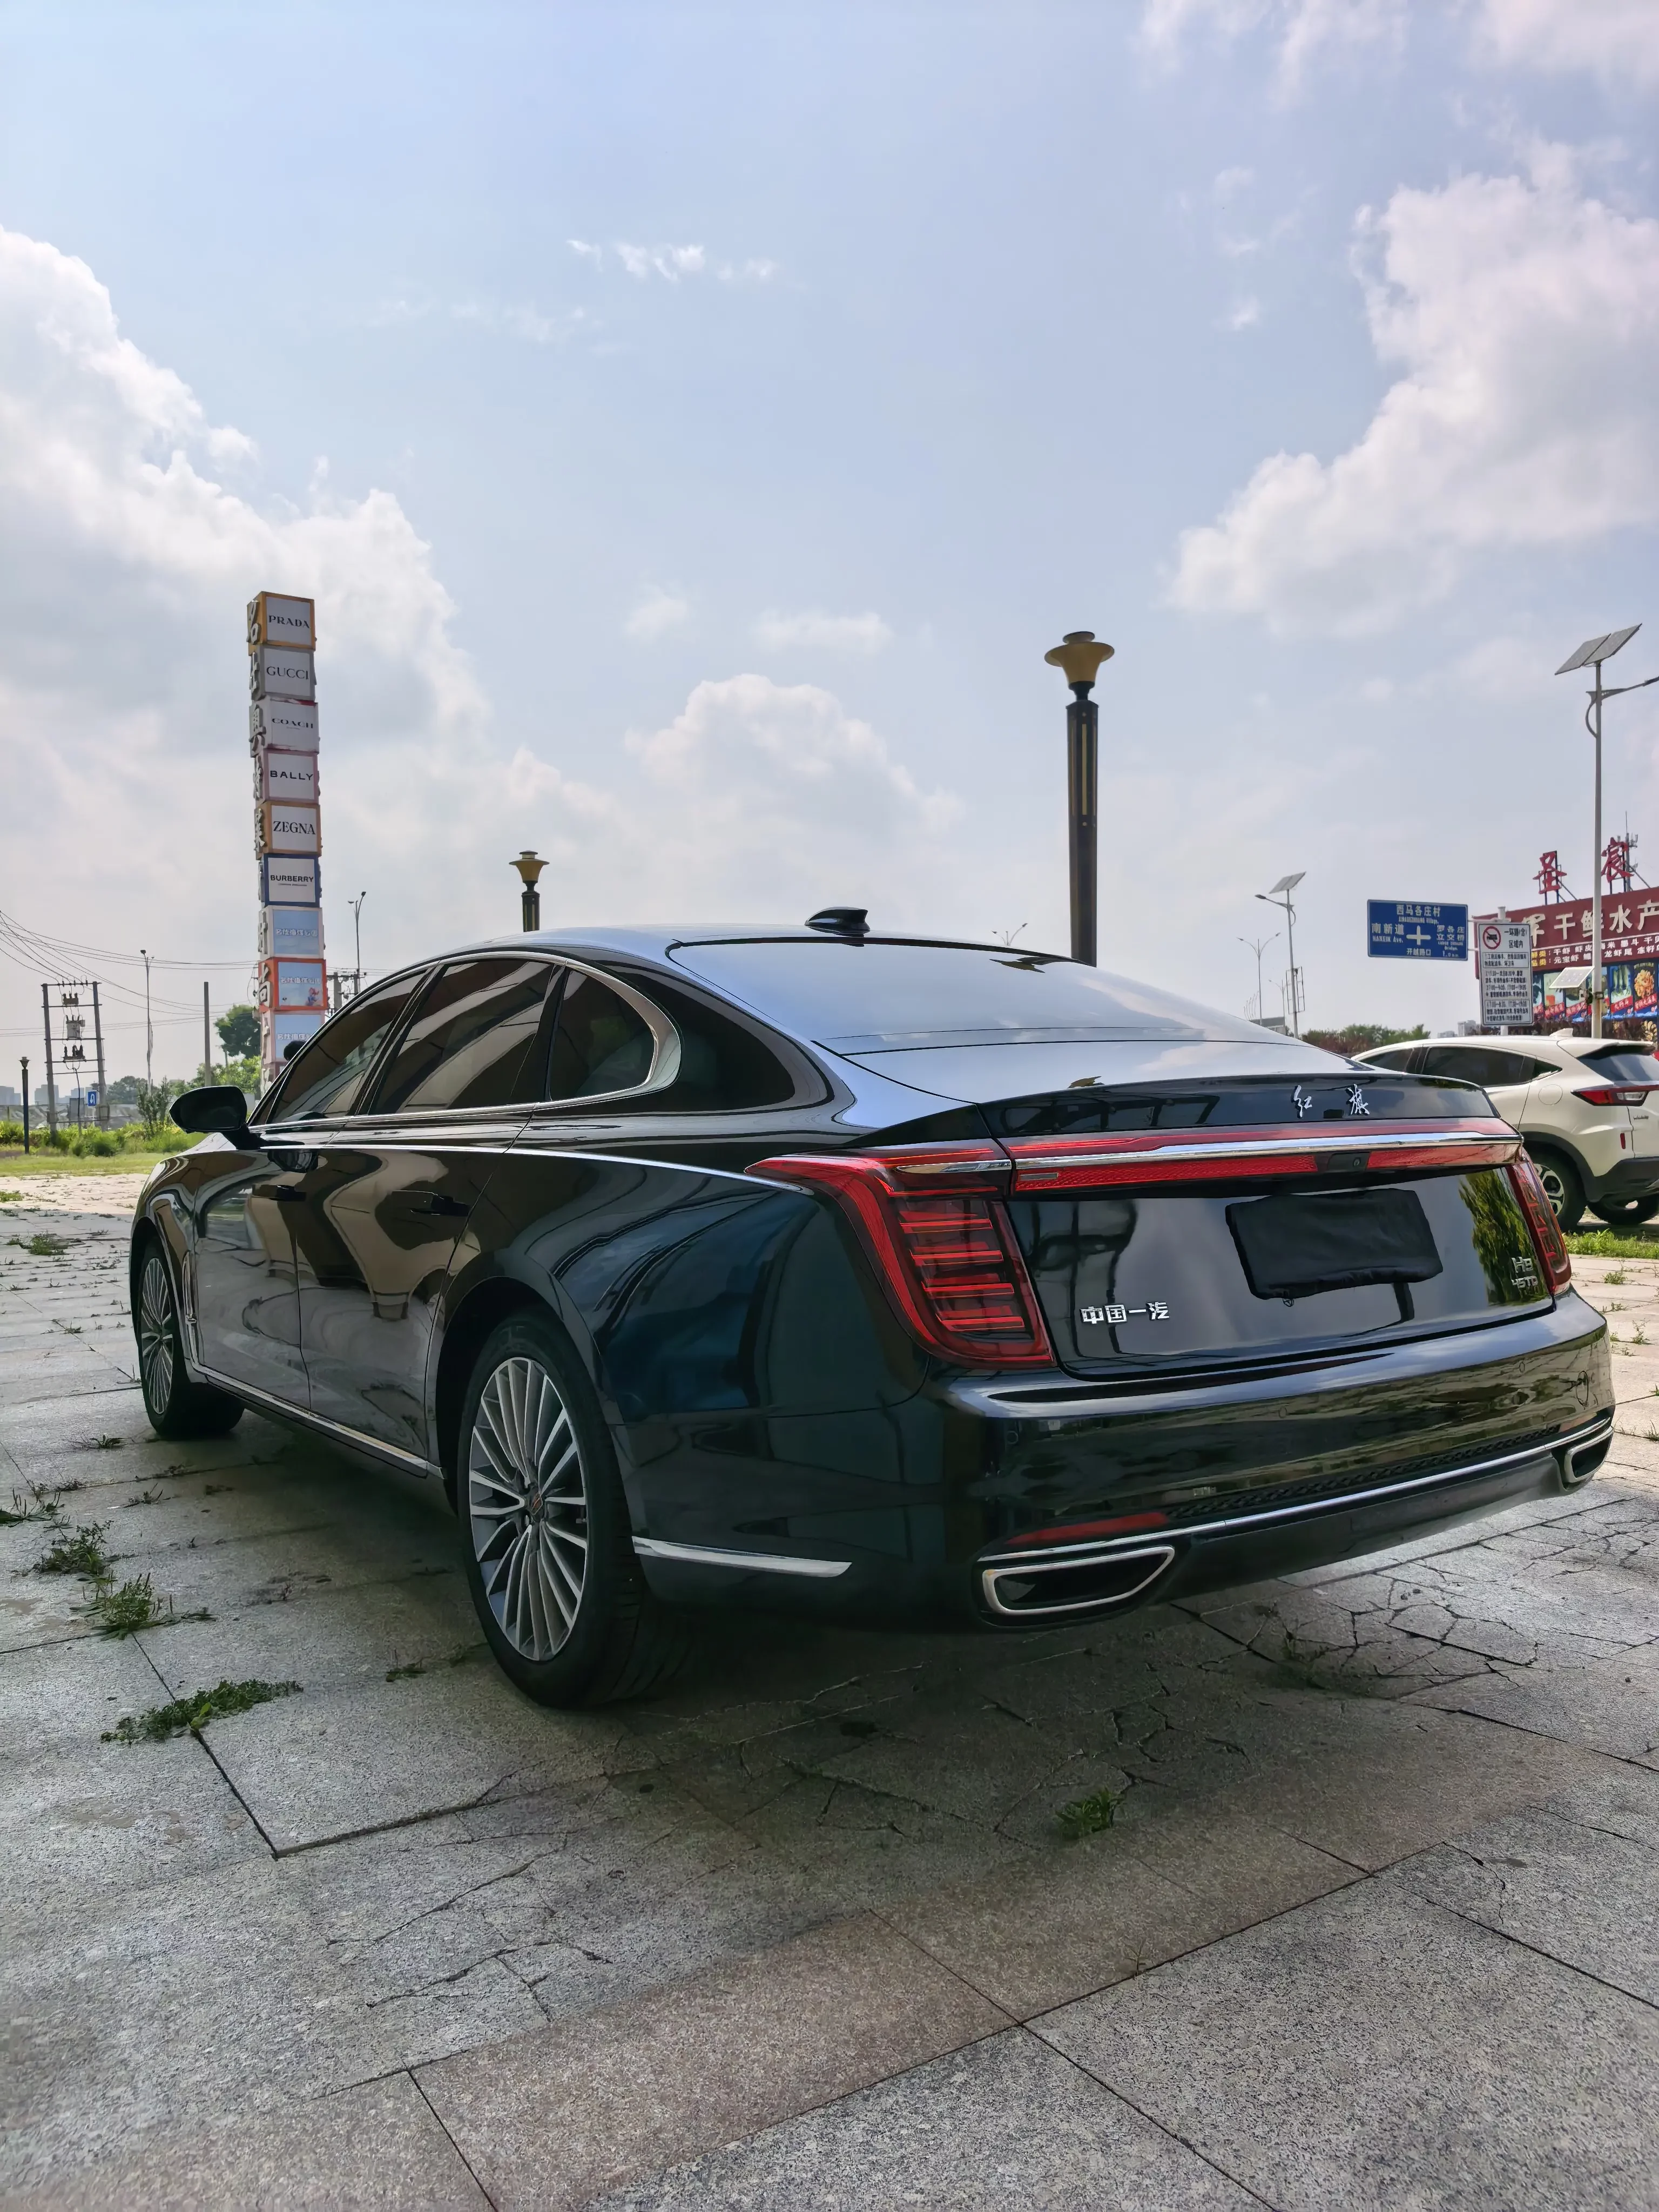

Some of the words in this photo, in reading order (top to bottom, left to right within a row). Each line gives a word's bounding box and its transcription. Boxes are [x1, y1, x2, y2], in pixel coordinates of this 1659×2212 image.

[268, 615, 310, 629] PRADA
[266, 666, 308, 679] GUCCI
[272, 718, 313, 729] COACH
[270, 771, 314, 780] BALLY
[273, 821, 315, 835] ZEGNA
[1372, 923, 1404, 935] 南新道
[1293, 1084, 1370, 1117] 红旗
[1511, 1257, 1533, 1273] H9
[1080, 1301, 1170, 1324] 中国一汽
